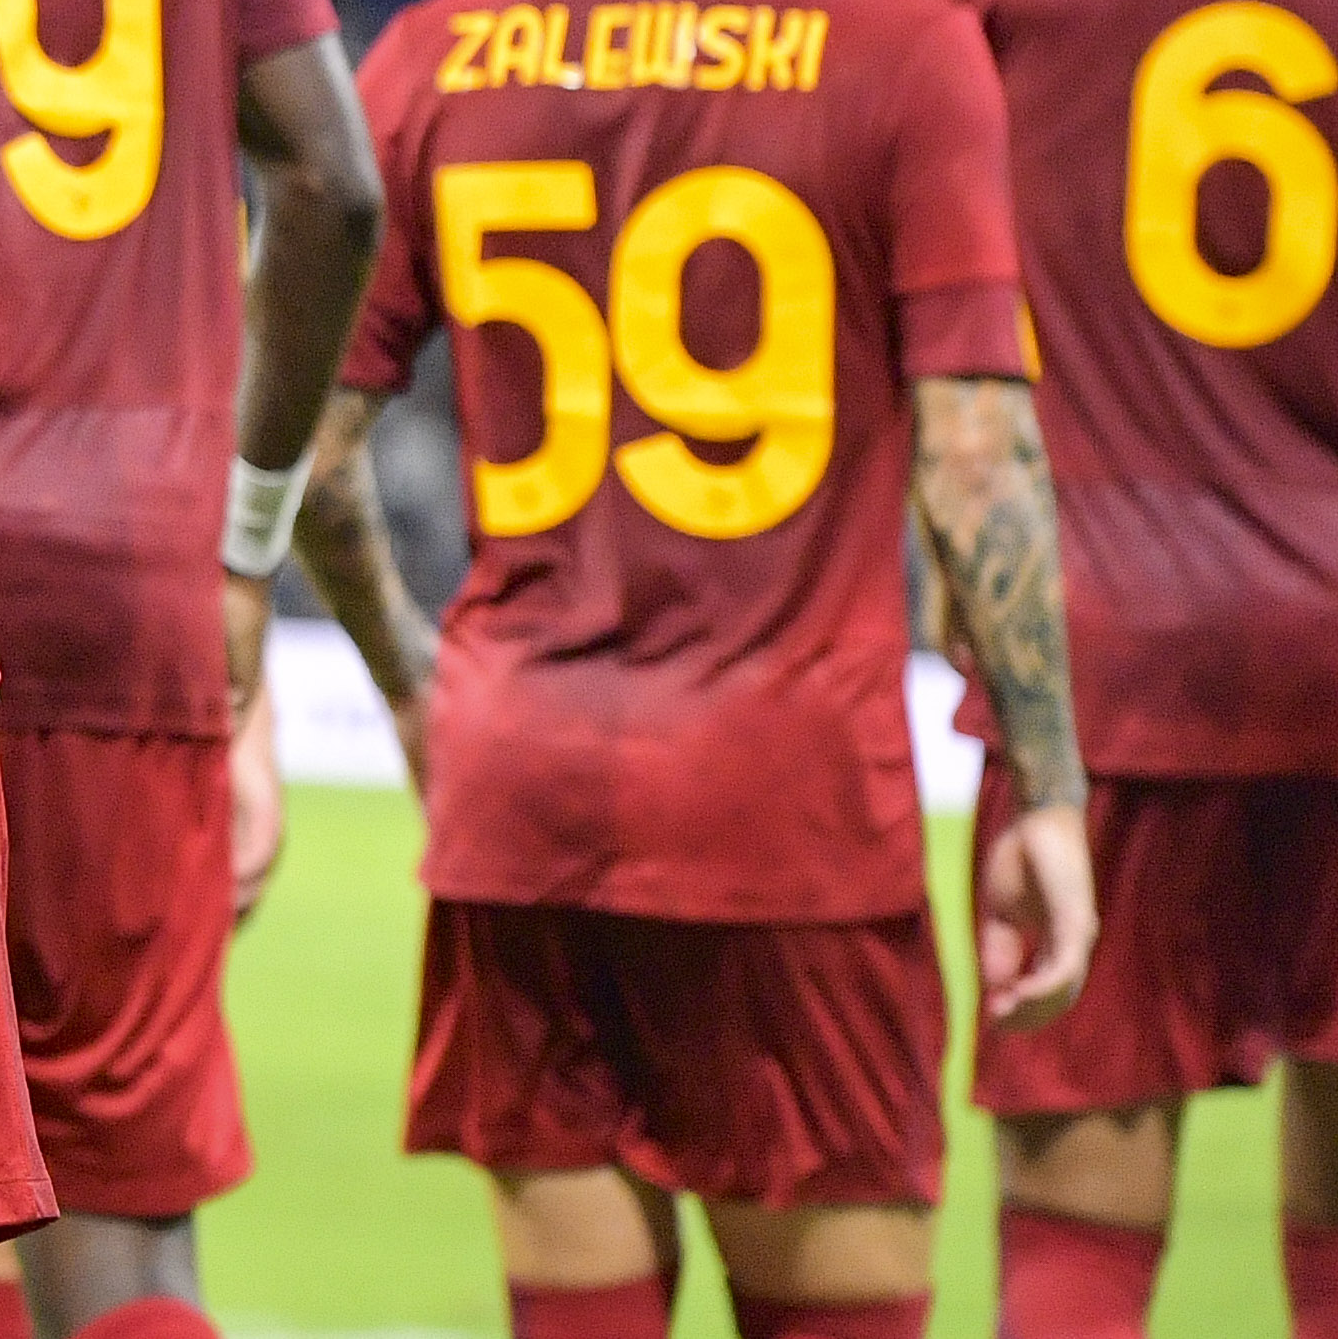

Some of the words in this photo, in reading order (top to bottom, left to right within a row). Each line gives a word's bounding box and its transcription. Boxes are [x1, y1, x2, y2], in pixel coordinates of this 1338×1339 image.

[436, 1, 830, 94] ZALEWSKI
[1127, 0, 1338, 348] 6
[434, 161, 835, 538] 59
